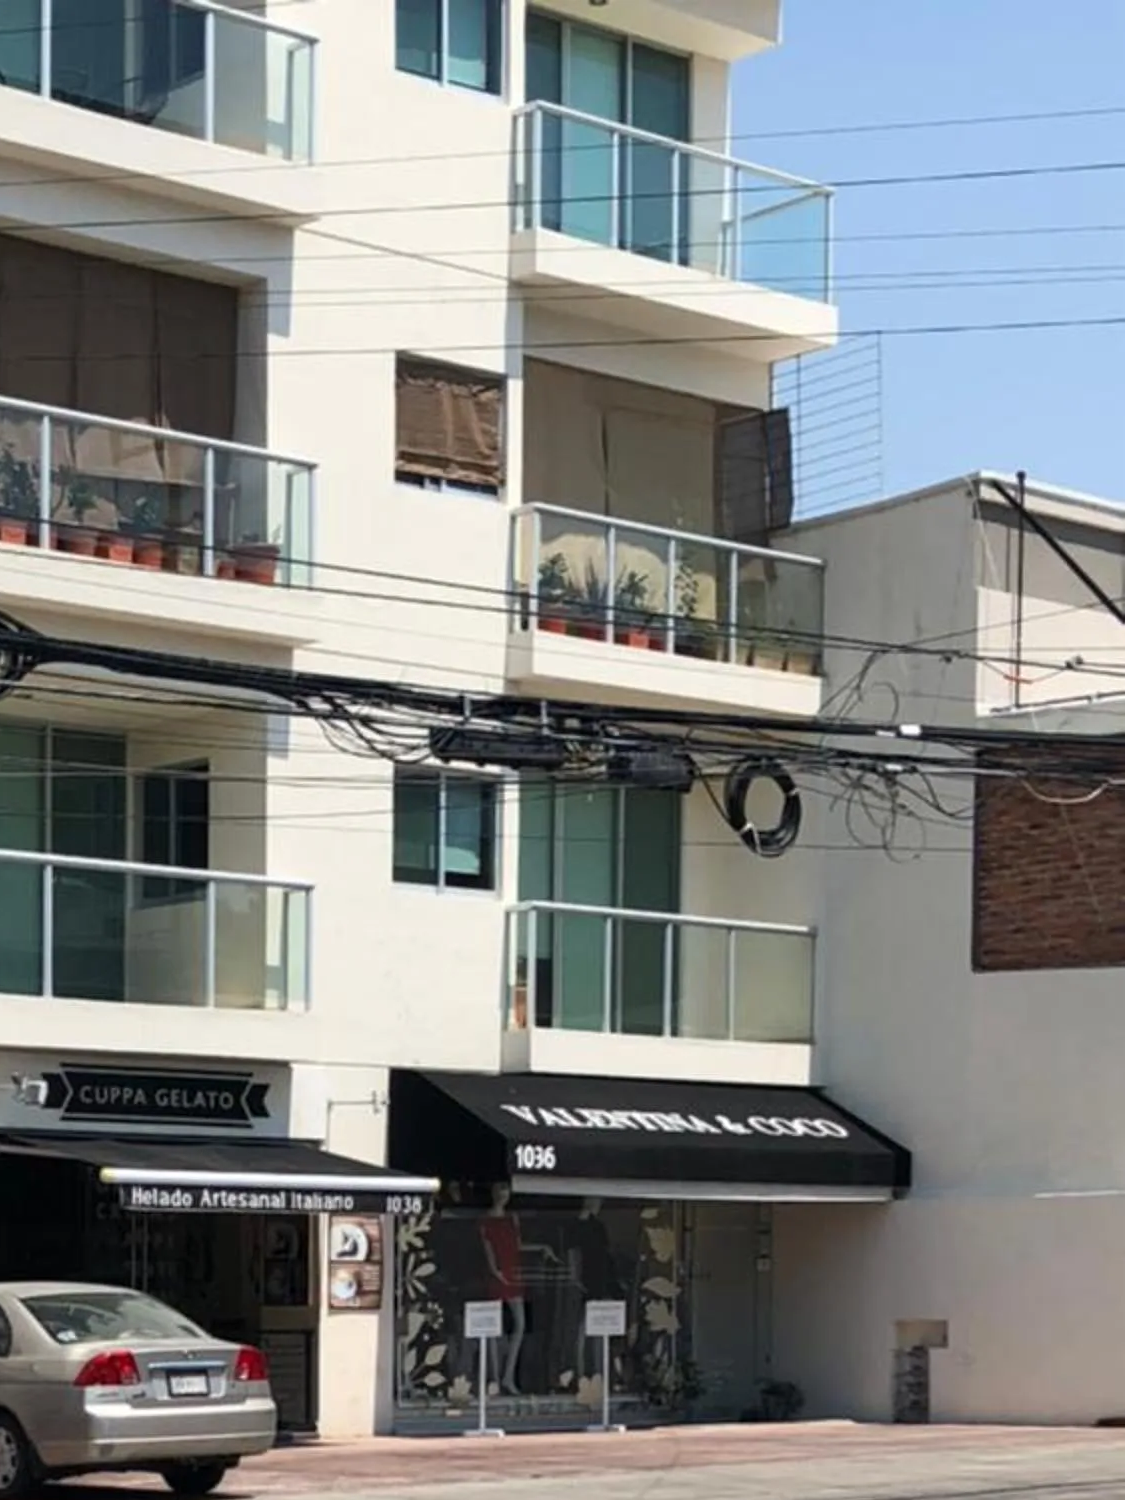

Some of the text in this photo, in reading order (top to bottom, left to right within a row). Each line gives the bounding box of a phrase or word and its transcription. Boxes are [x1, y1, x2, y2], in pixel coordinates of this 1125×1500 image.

[79, 1085, 234, 1110] CUPPA GELATO
[500, 1103, 723, 1134] VALENTINA
[747, 1115, 849, 1138] COCO
[515, 1145, 556, 1169] 1036
[131, 1187, 354, 1210] Helado Artesanal Italiano
[386, 1196, 423, 1214] 1038
